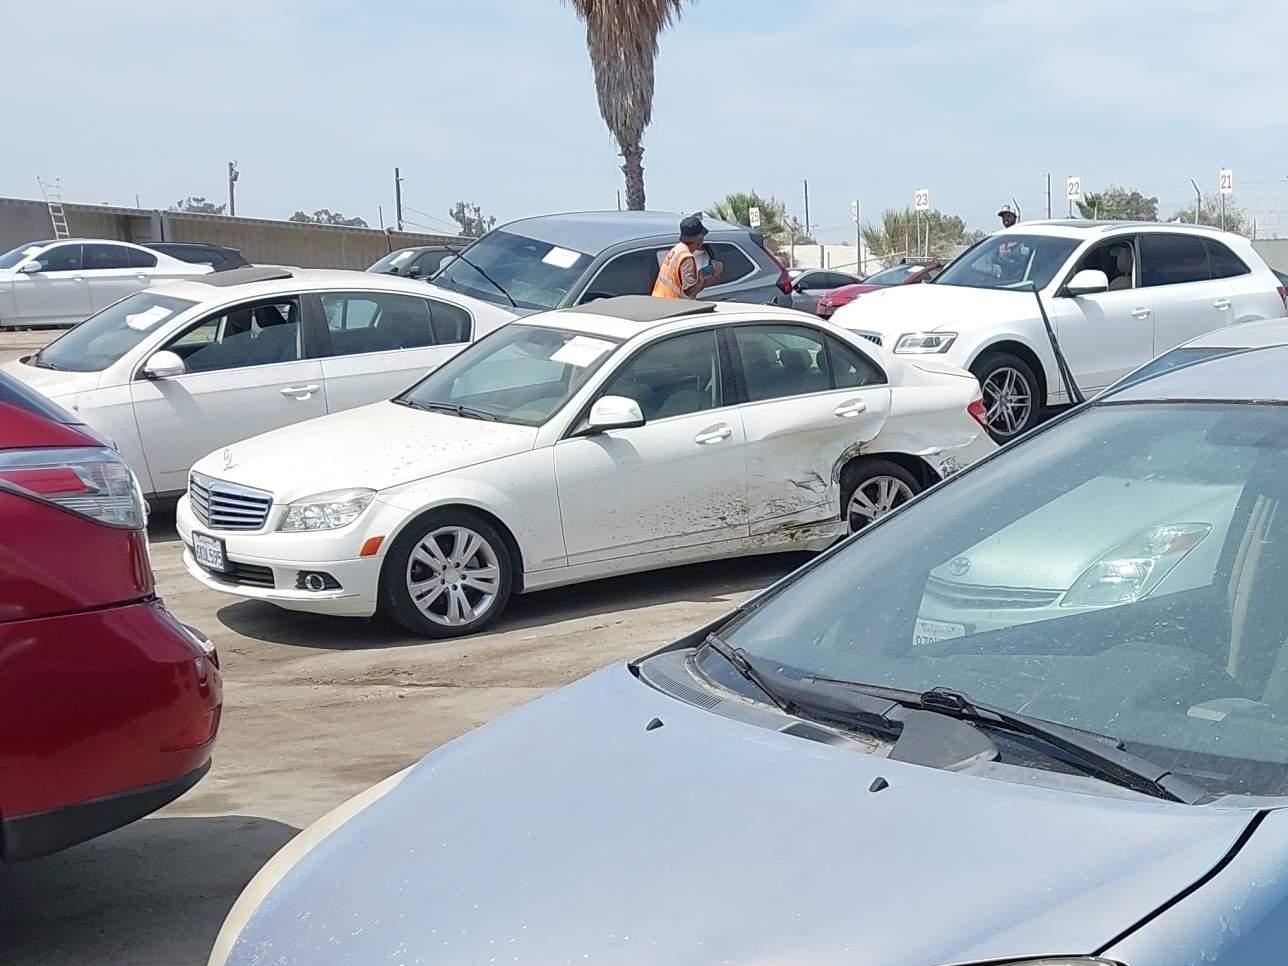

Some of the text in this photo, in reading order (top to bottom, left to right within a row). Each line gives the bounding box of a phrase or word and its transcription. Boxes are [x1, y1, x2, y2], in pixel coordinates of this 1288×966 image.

[1221, 174, 1232, 189] 21
[1068, 182, 1080, 196] 22
[916, 193, 928, 206] 23
[751, 211, 759, 223] 25
